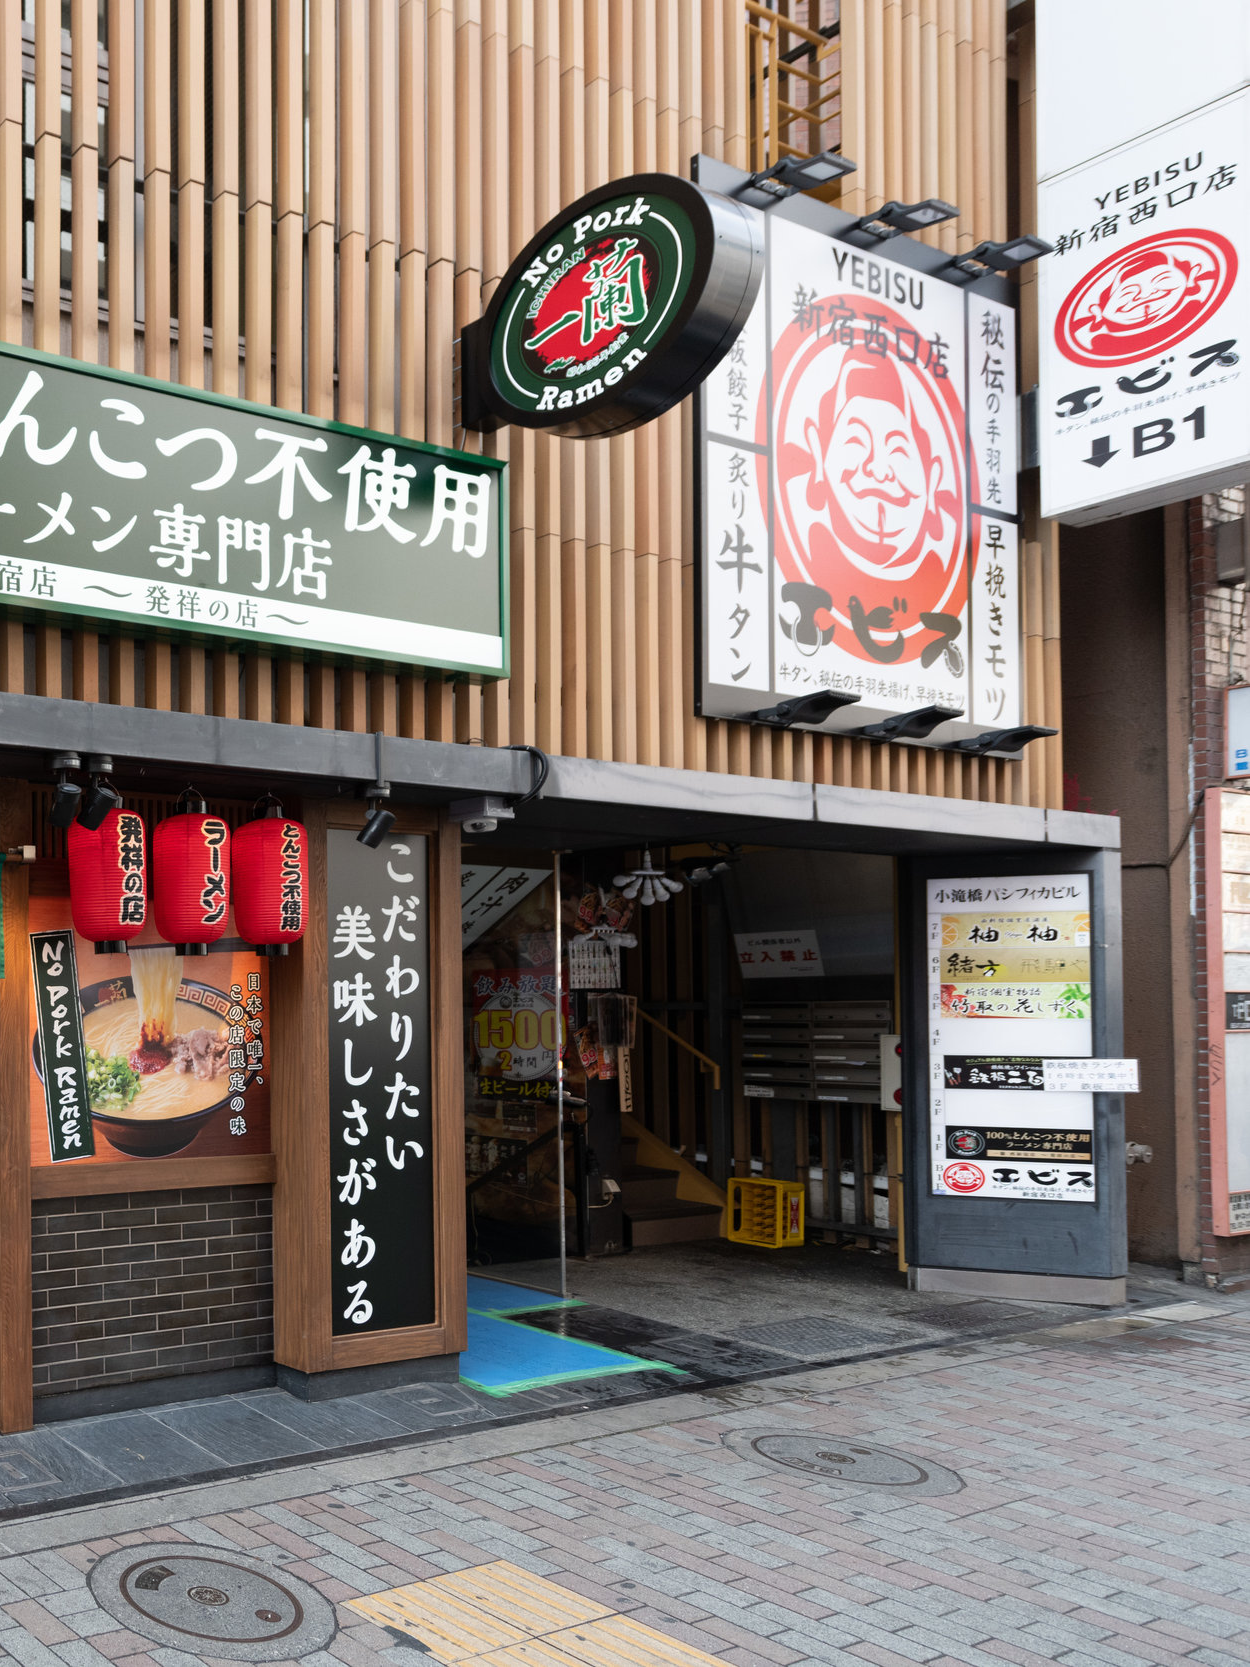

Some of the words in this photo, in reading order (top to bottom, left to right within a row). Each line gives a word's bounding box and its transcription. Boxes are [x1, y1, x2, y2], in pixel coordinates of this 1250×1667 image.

[1052, 163, 1238, 257] 新宿西口店
[1094, 151, 1204, 211] YEBISU
[521, 240, 564, 288] No
[572, 197, 651, 245] Pork
[526, 247, 586, 320] ICHIRAN
[831, 246, 924, 312] YEBISU
[524, 237, 650, 350] 一蘭
[791, 283, 950, 380] 新宿西口店
[535, 346, 648, 412] Ramen
[726, 327, 748, 432] 板餃子
[979, 310, 1006, 506] 秘伝の手羽先
[1132, 404, 1207, 459] B1
[715, 451, 764, 684] 炙り牛タン
[983, 523, 1008, 722] 早挽きモツ
[119, 812, 147, 925] 発祥の店
[201, 819, 228, 925] ラーメン
[279, 823, 303, 933] とんこつ不使用
[934, 886, 1082, 904] 小滝橋パシフィカビル
[42, 940, 65, 977] No
[740, 948, 819, 964] 立入禁止
[46, 984, 74, 1059] Pork
[381, 842, 424, 1171] こだわりたい
[473, 1009, 567, 1051] 1500
[227, 983, 247, 1137] この店限定の味
[53, 1065, 83, 1150] Ramen
[332, 905, 378, 1324] 美味しさがある
[992, 1168, 1094, 1188] エビス
